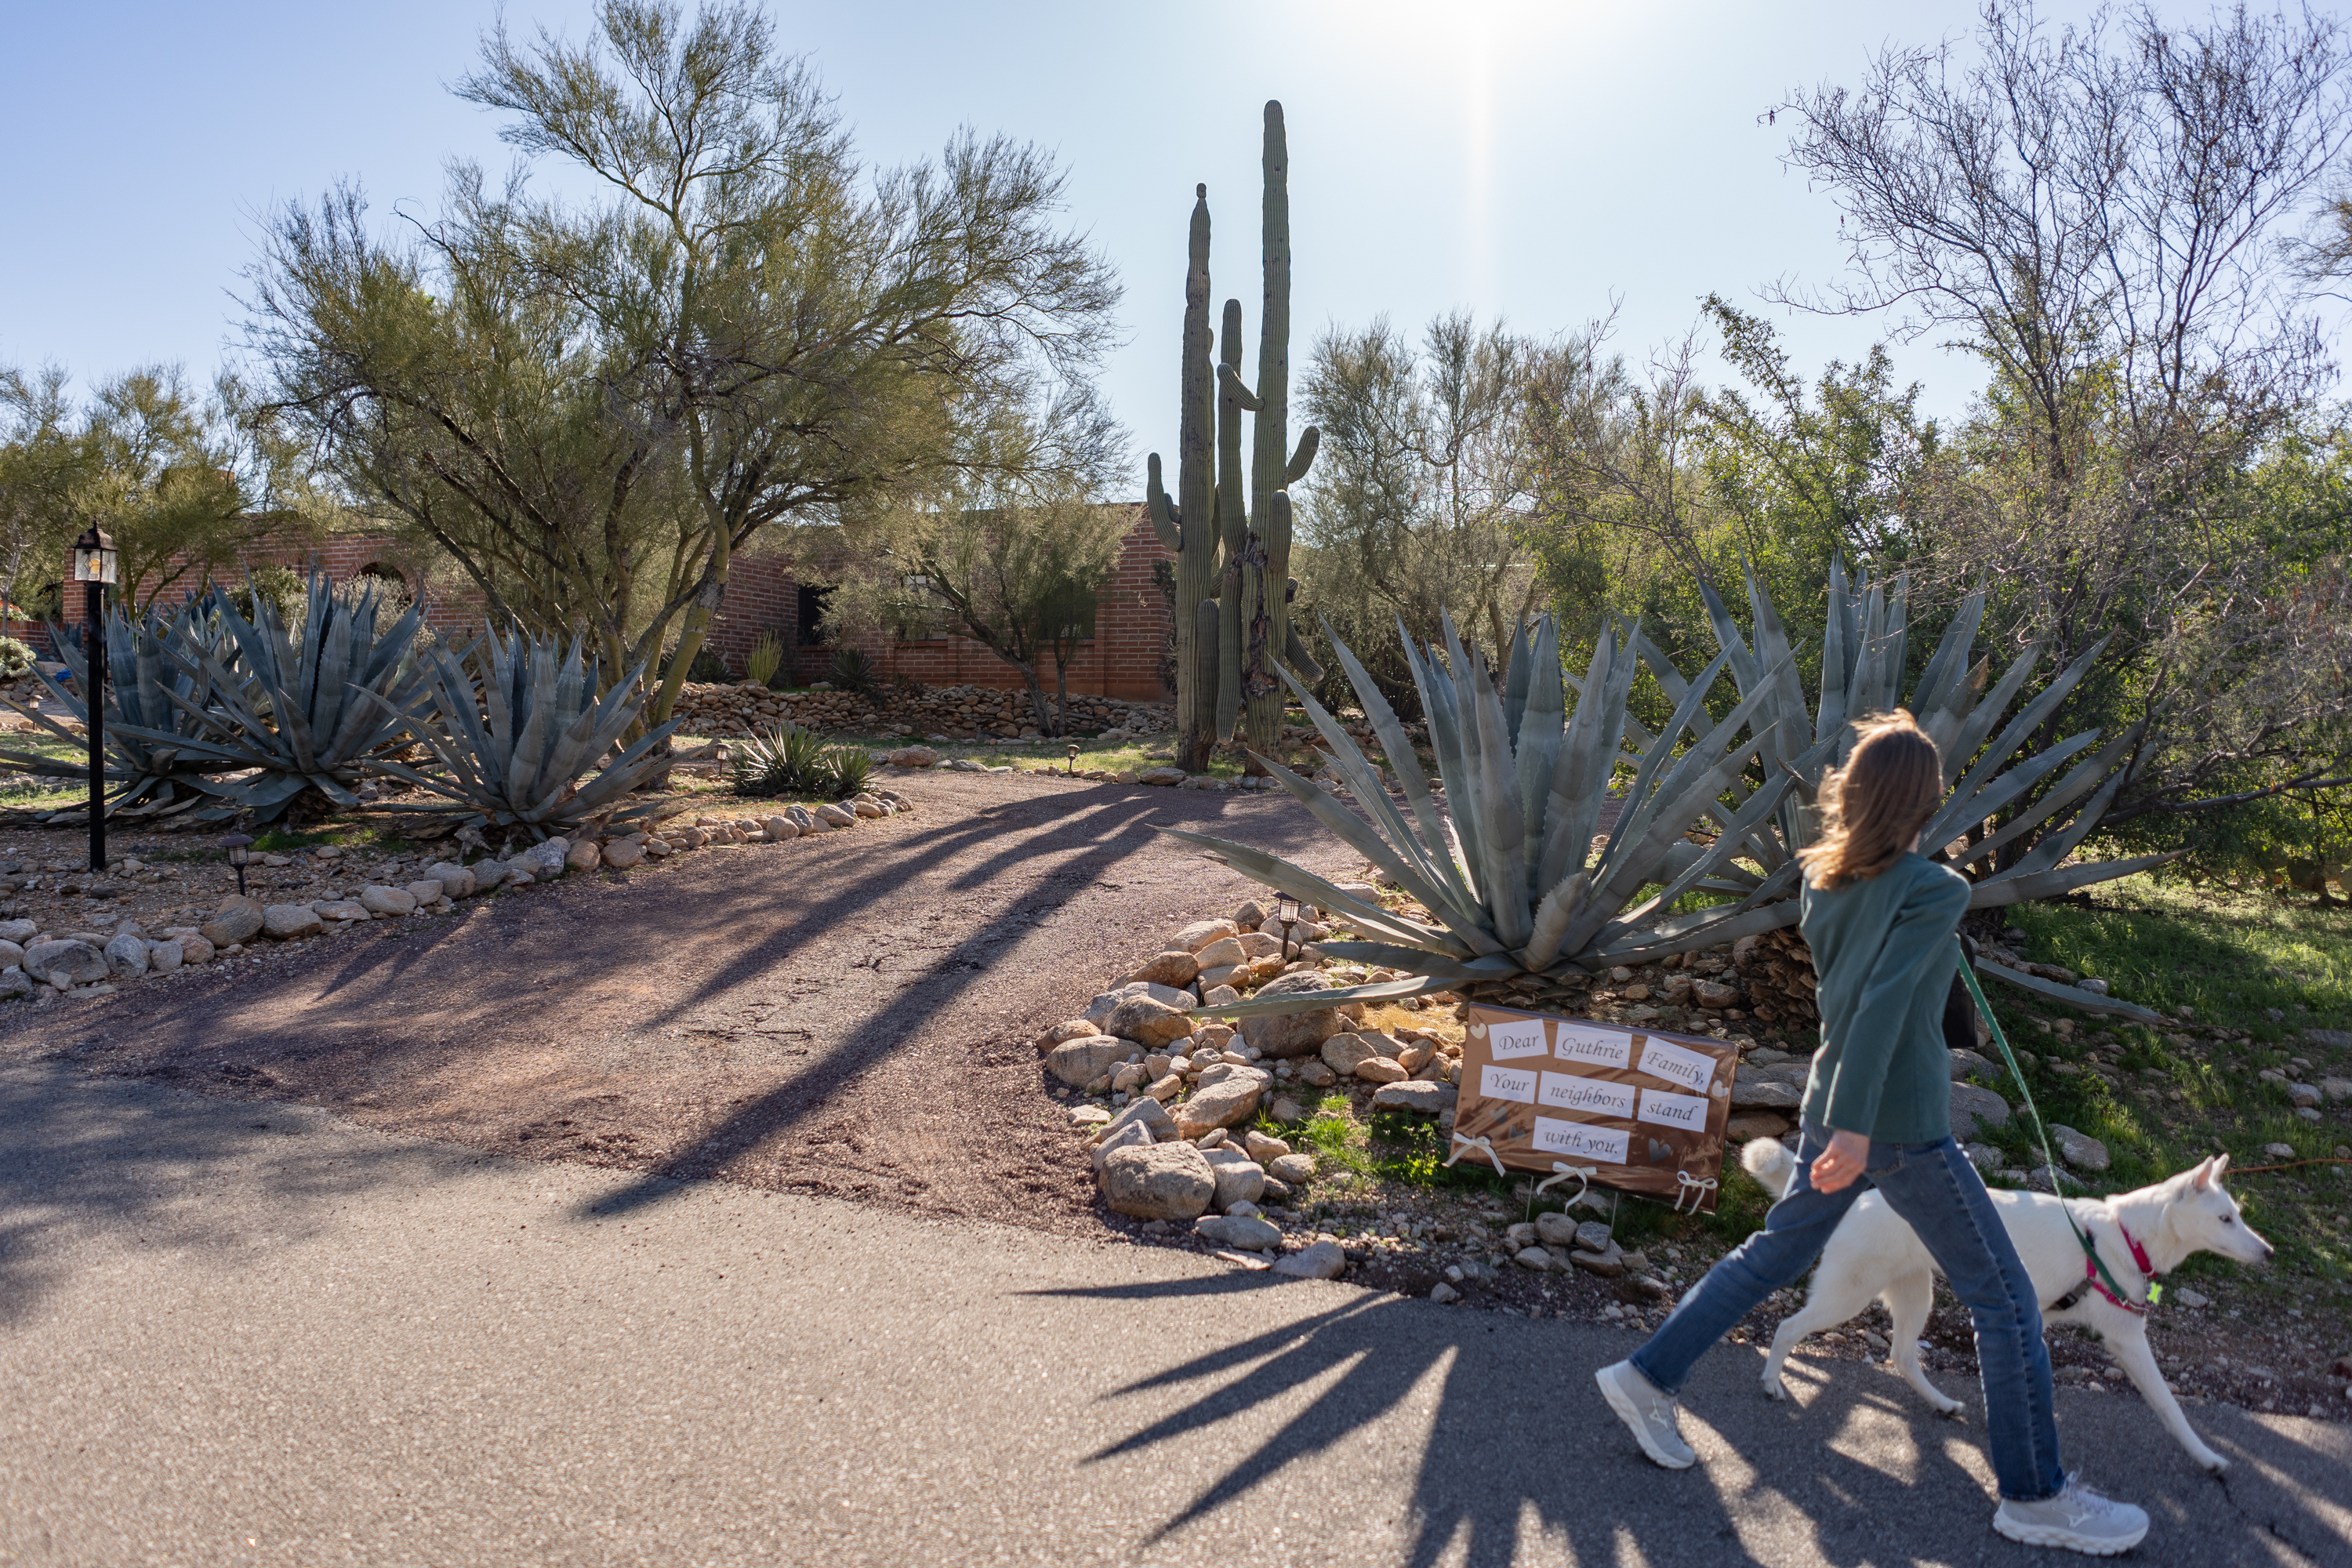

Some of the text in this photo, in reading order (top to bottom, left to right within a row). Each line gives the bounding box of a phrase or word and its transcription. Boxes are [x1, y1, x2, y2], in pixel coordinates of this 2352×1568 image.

[1499, 1035, 1704, 1086] Dear Guthrie Family,
[1490, 1073, 1698, 1121] Your neighbors stand
[1544, 1131, 1618, 1154] with you.
